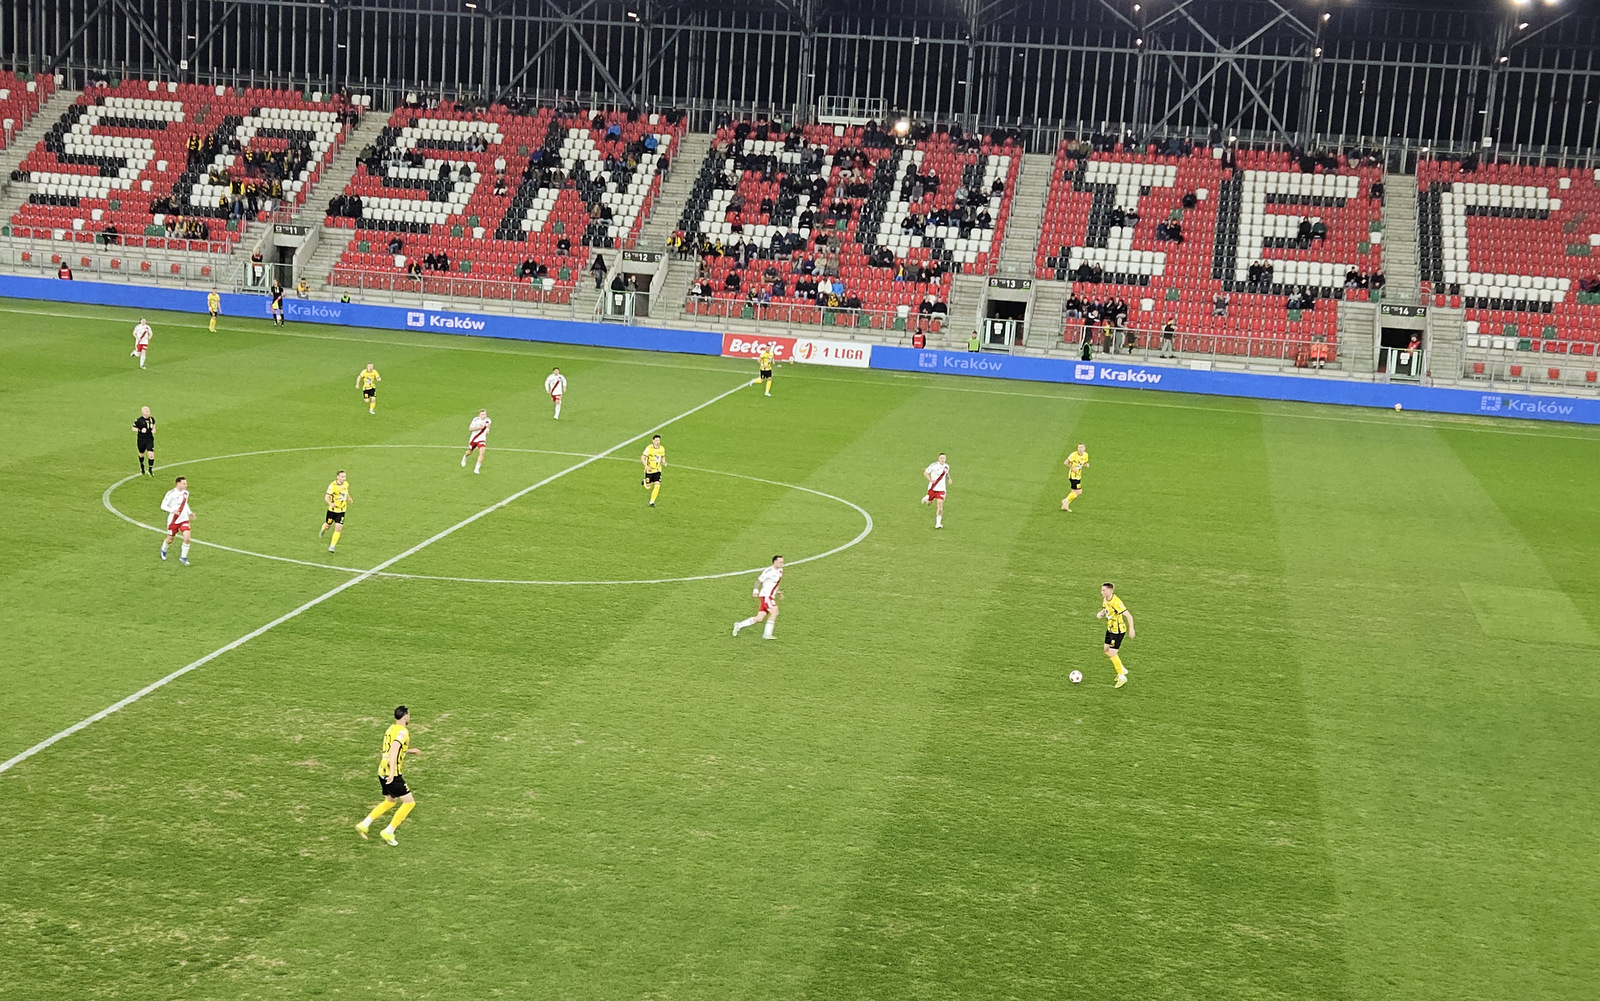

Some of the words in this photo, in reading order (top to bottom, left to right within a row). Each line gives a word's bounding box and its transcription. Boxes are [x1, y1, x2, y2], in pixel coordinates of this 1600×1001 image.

[289, 226, 298, 235] 11
[639, 253, 648, 261] 12
[1006, 280, 1016, 288] 13
[288, 304, 342, 318] Kraków
[1399, 307, 1409, 316] 14
[430, 315, 486, 330] Kraków
[834, 348, 863, 360] LIGA
[944, 356, 1003, 371] Kraków
[1100, 368, 1162, 384] Kraków
[1507, 399, 1574, 415] Kraków
